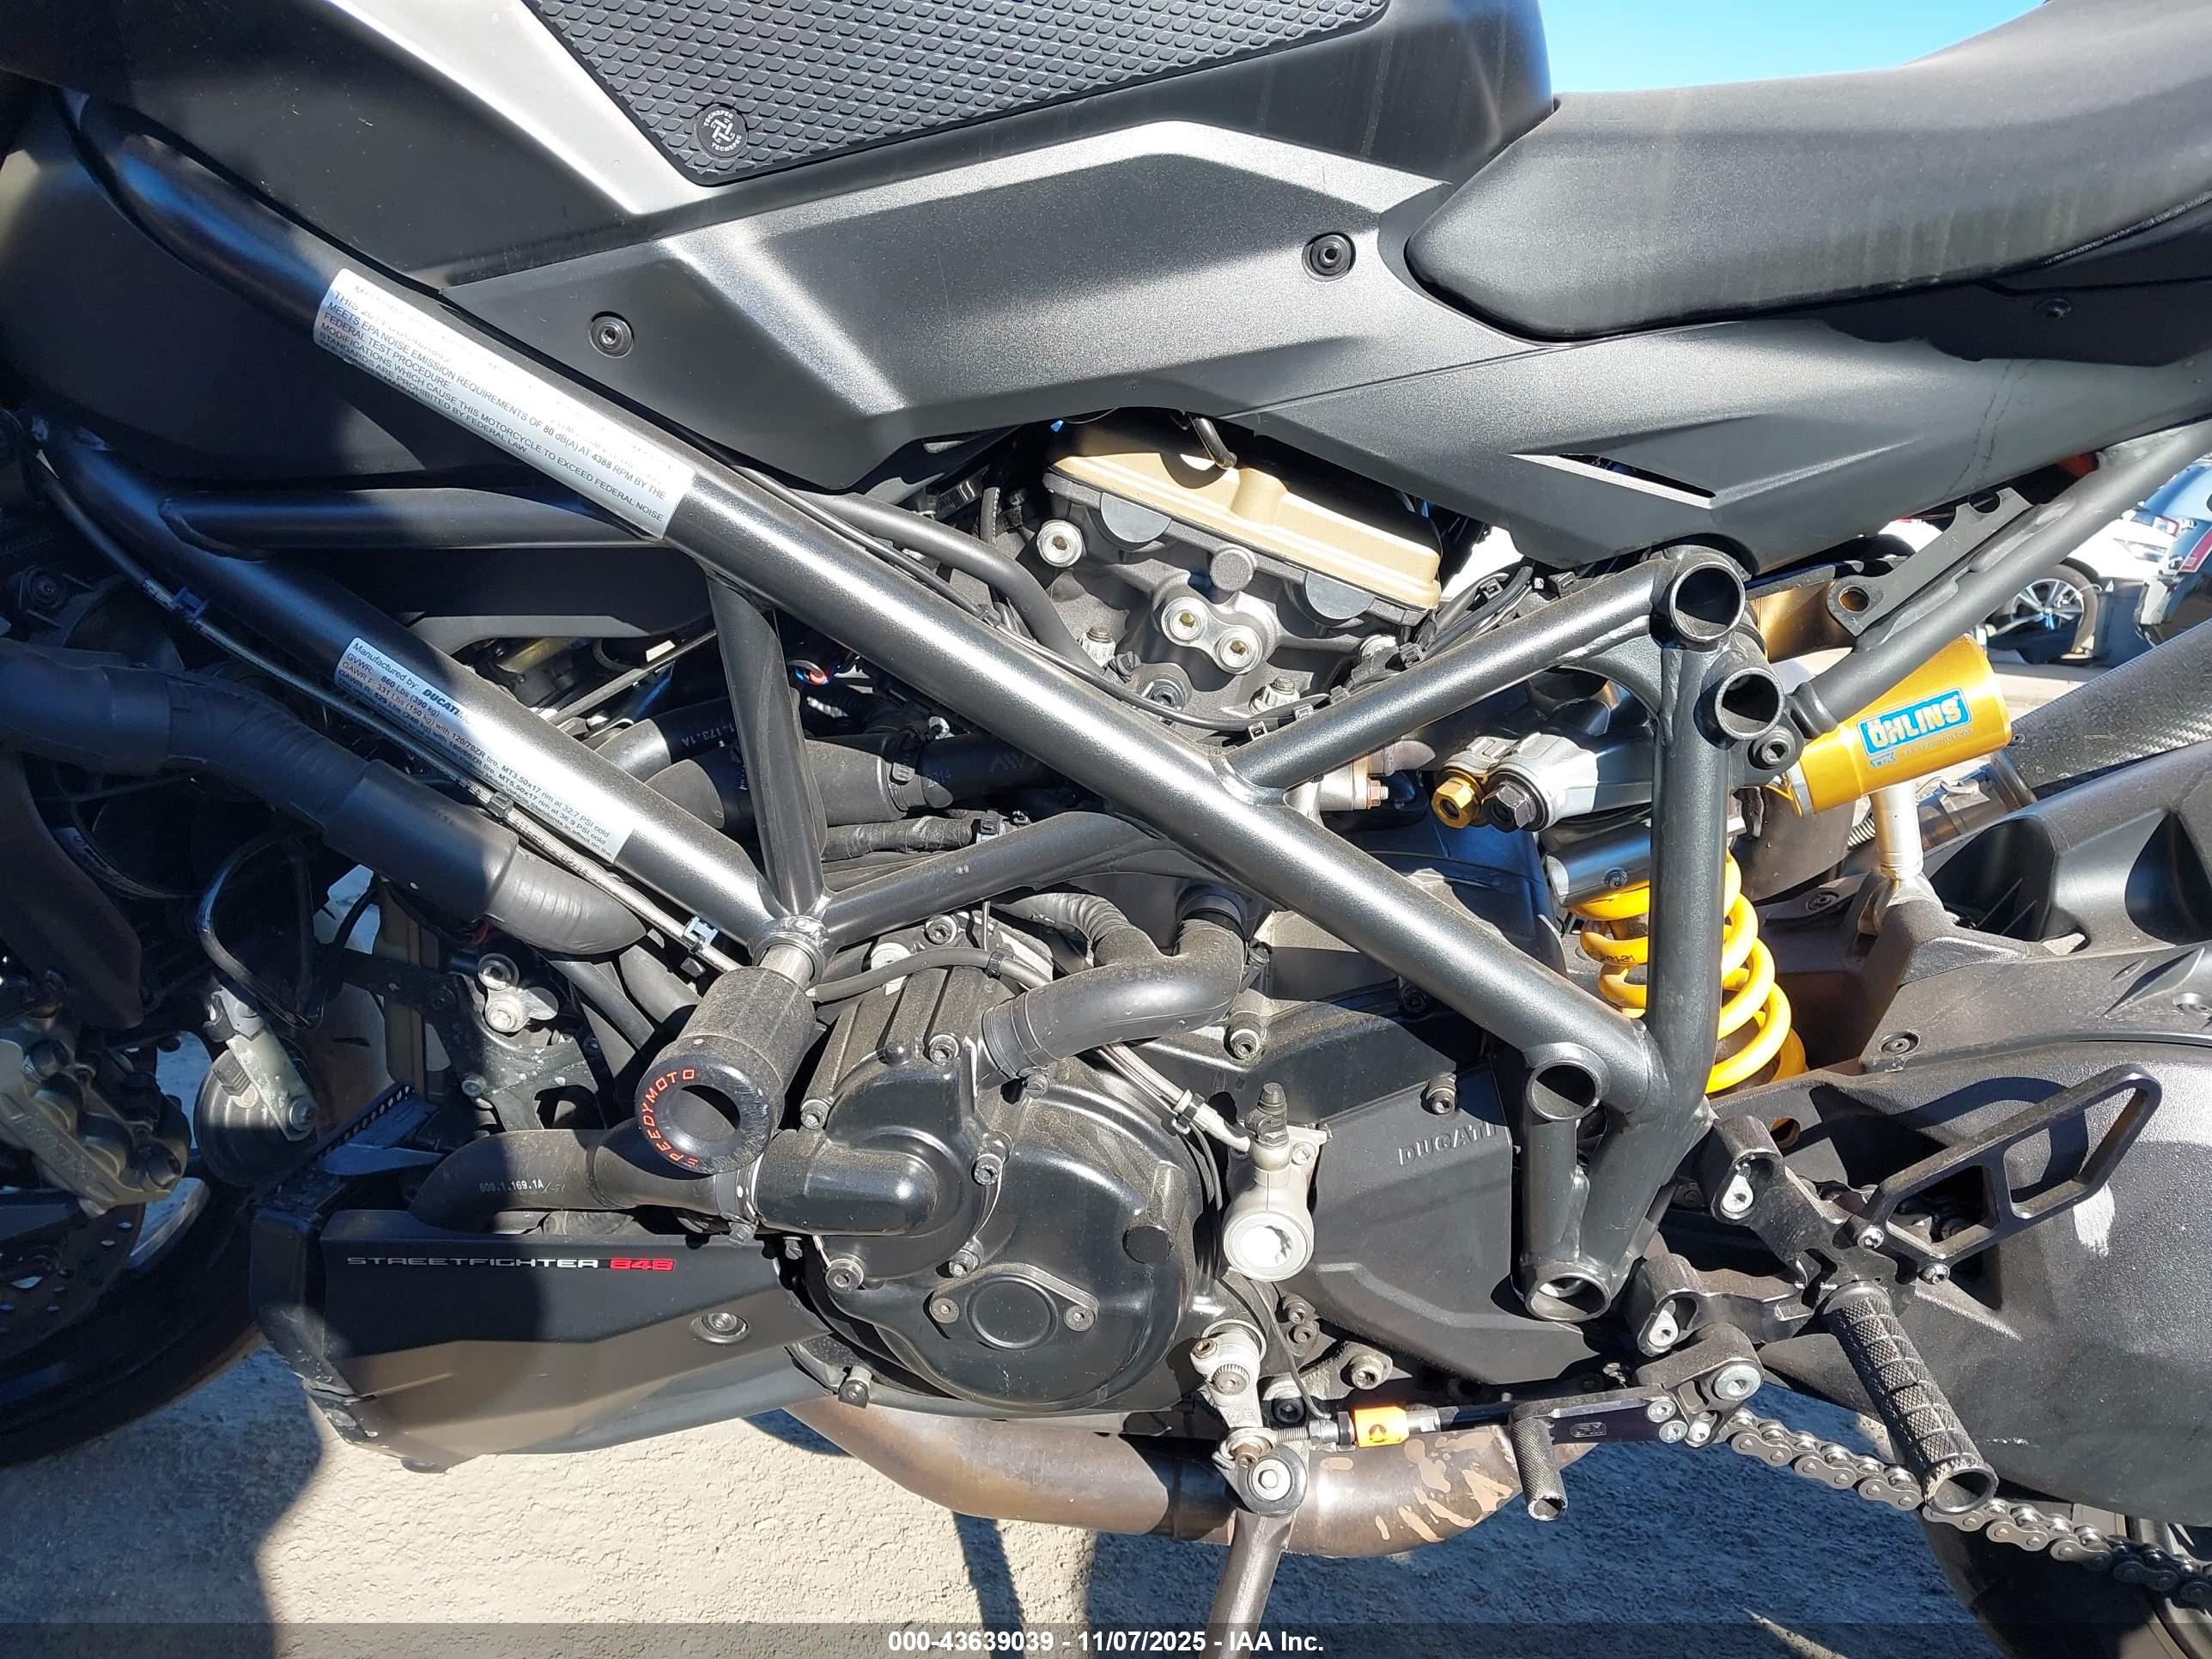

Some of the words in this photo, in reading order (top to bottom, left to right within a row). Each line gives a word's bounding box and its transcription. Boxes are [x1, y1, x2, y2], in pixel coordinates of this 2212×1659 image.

[333, 291, 360, 311] THIS
[322, 311, 368, 342] FEDERAL
[367, 337, 392, 356] TEST
[391, 350, 453, 392] PROCEDURE.
[319, 330, 375, 368] STANDARDS
[375, 362, 395, 378] ARE
[395, 374, 451, 410] PROHIBITED
[451, 406, 464, 417] BY
[465, 414, 507, 442] FEDERAL
[506, 438, 529, 454] LAW.
[319, 320, 393, 368] MODIFICATIONS
[392, 362, 426, 386] WHICH
[424, 380, 459, 404] CAUSE
[458, 399, 480, 417] THIS
[479, 411, 543, 453] MOTORCYCLE
[541, 447, 556, 461] TO
[556, 456, 594, 483] EXCEED
[593, 477, 635, 507] FEDERAL
[635, 501, 664, 522] NOISE
[326, 301, 362, 326] MEETS
[360, 320, 381, 337] EPA
[380, 331, 410, 355] NOISE
[410, 349, 456, 380] EMISSION
[455, 374, 528, 422] REQUIREMENTS
[527, 416, 543, 429] OF
[542, 424, 555, 436] 80
[554, 431, 580, 451] dB(A)
[577, 445, 591, 457] AT
[590, 452, 612, 470] 4388
[611, 465, 634, 482] RPM
[633, 477, 647, 489] BY
[646, 484, 666, 500] THE
[352, 641, 407, 681] Manufactured
[404, 678, 420, 691] by:
[422, 688, 459, 716] DUCATI
[380, 674, 396, 688] 860
[395, 684, 410, 697] Lbs
[408, 694, 428, 710] (390
[425, 705, 441, 719] kg)
[337, 668, 363, 688] GAWR
[538, 798, 551, 809] rim
[550, 806, 559, 815] at
[575, 823, 590, 835] PSI
[589, 831, 606, 845] cold
[341, 660, 368, 681] GAWR
[375, 683, 391, 696] 331
[390, 693, 405, 706] Lbs
[404, 702, 422, 718] (150
[421, 713, 435, 726] kg)
[434, 721, 451, 735] with
[451, 732, 486, 758] 120/70ZR
[500, 764, 541, 794] MT3.50x17
[540, 790, 555, 802] rim
[553, 799, 563, 807] at
[579, 815, 594, 828] PSI
[592, 823, 610, 838] cold
[1865, 695, 1962, 748] ÖHLINS
[1398, 1121, 1497, 1165] DUCATI
[346, 1255, 599, 1268] STREETFIGHTER
[609, 1257, 677, 1271] 848
